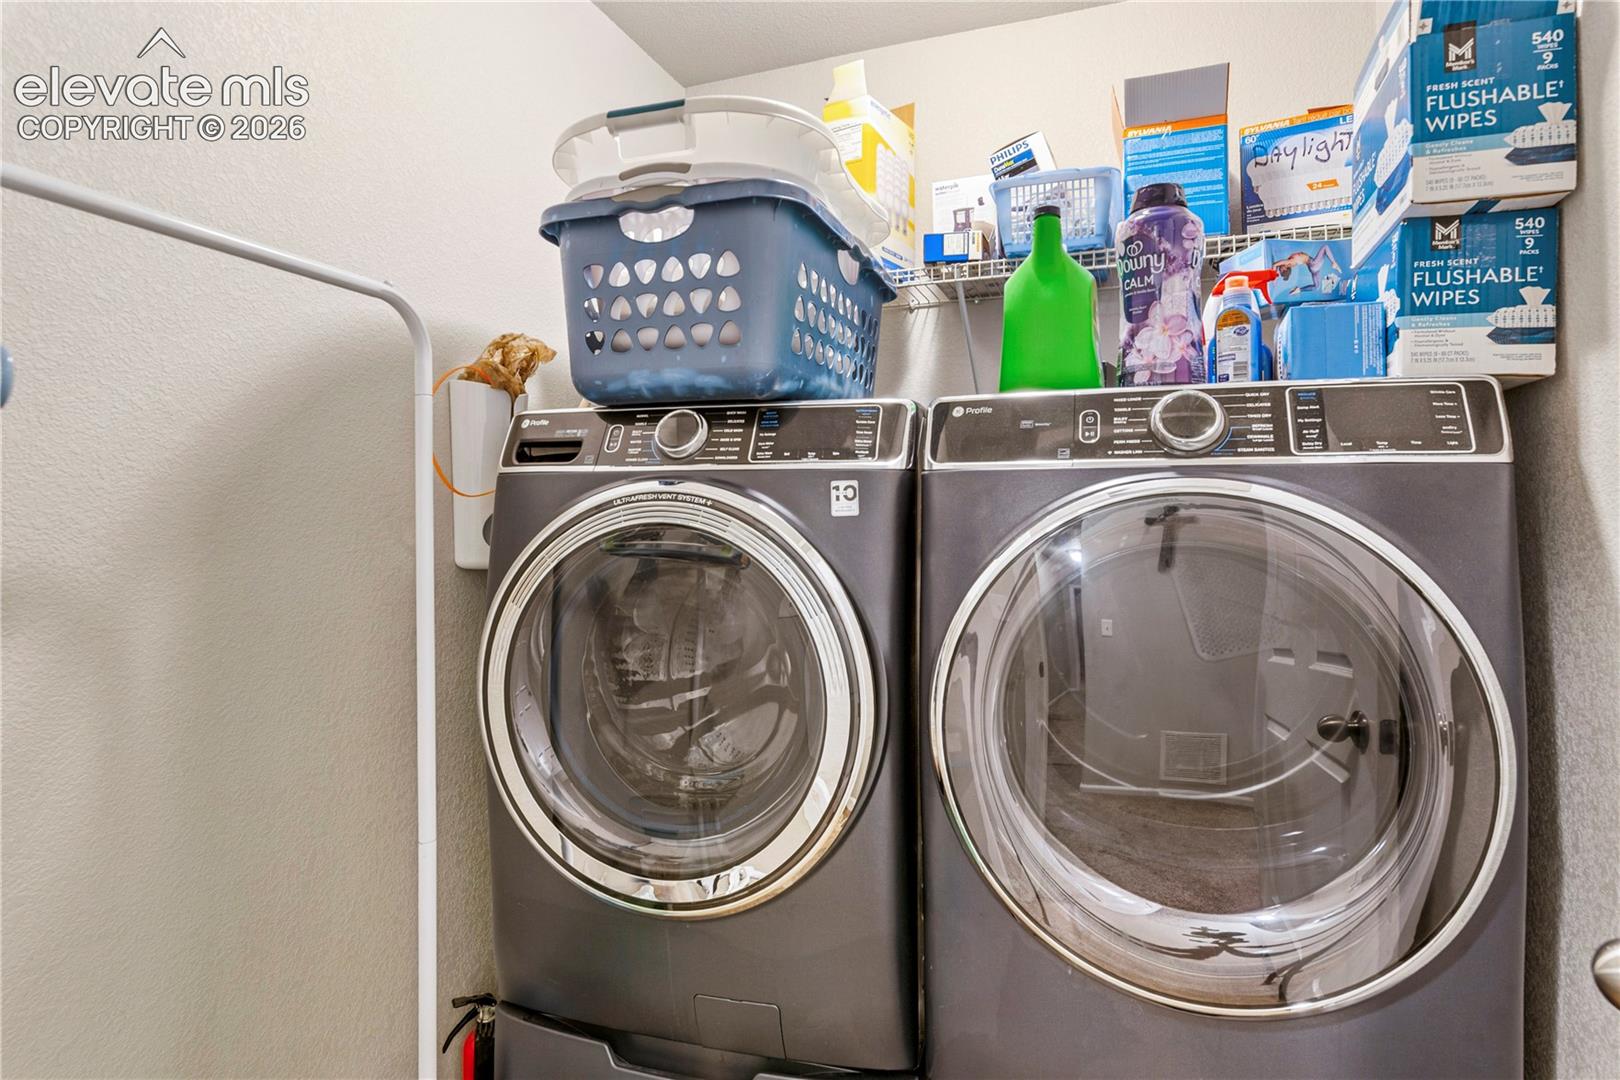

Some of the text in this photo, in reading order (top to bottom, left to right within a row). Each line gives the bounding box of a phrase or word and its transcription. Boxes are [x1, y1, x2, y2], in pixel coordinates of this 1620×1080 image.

[1531, 29, 1564, 45] 540
[1542, 52, 1553, 64] 9
[1426, 77, 1495, 92] FRESH SCENT
[1244, 120, 1290, 134] SYLVANIA
[1425, 110, 1498, 133] WIPES
[1128, 125, 1172, 138] SYLVANIA
[990, 140, 1030, 165] PHILIPS
[1515, 216, 1545, 230] 540
[1524, 238, 1534, 249] 9
[1414, 258, 1479, 268] FRESH SCENT
[1124, 276, 1154, 291] CALM
[1412, 289, 1480, 306] WIPES
[966, 406, 993, 415] Profile
[529, 418, 550, 427] Profile
[613, 493, 658, 506] ULTRAFRESH
[658, 492, 676, 501] VENT
